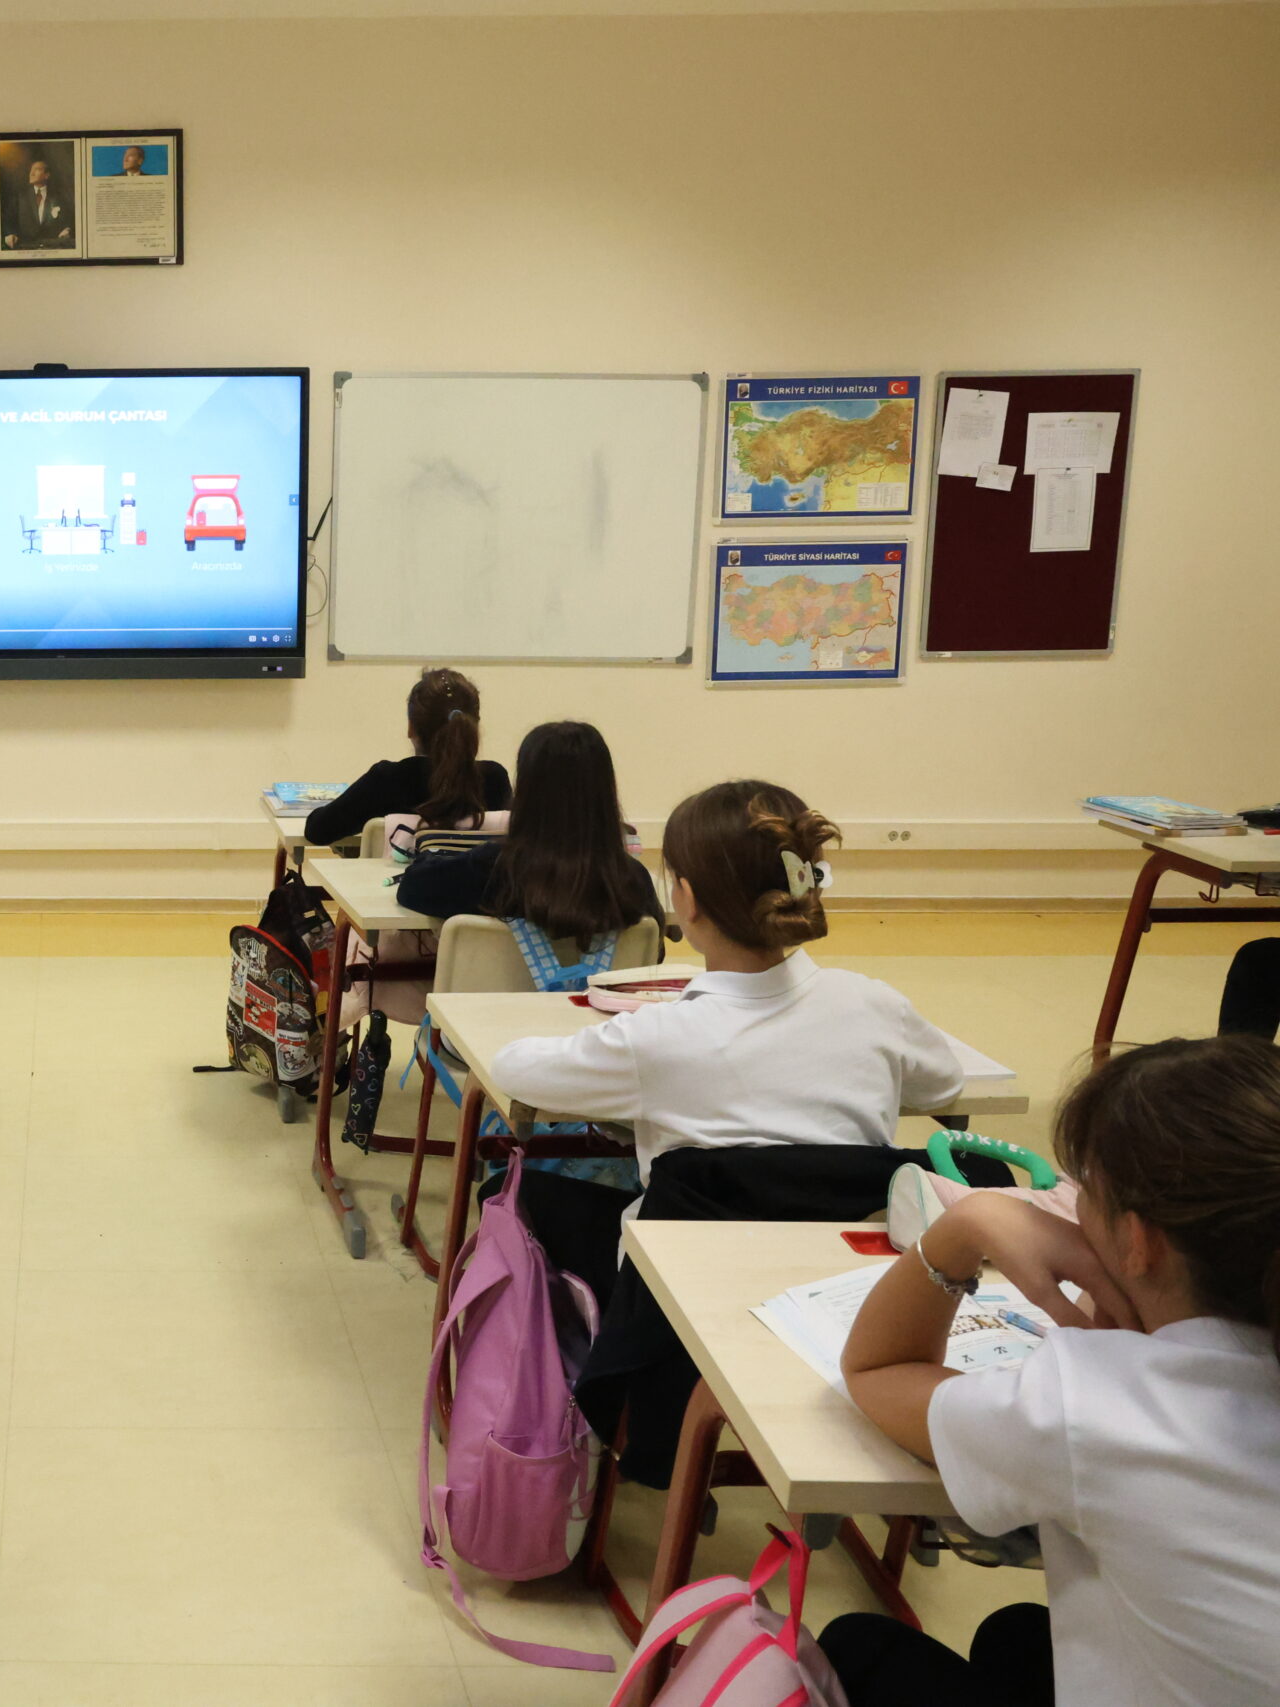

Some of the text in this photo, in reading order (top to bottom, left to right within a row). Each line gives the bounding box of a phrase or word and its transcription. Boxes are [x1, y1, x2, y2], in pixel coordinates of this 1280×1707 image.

[767, 385, 878, 395] TÜRKİYE FİZİKİ HARİTASI
[0, 411, 17, 423] VE
[20, 409, 51, 423] ACİL
[54, 411, 105, 422] DURUM
[108, 410, 167, 424] ÇANTASI
[764, 552, 860, 561] TÜRKİYE SİYASİ HARİTASI
